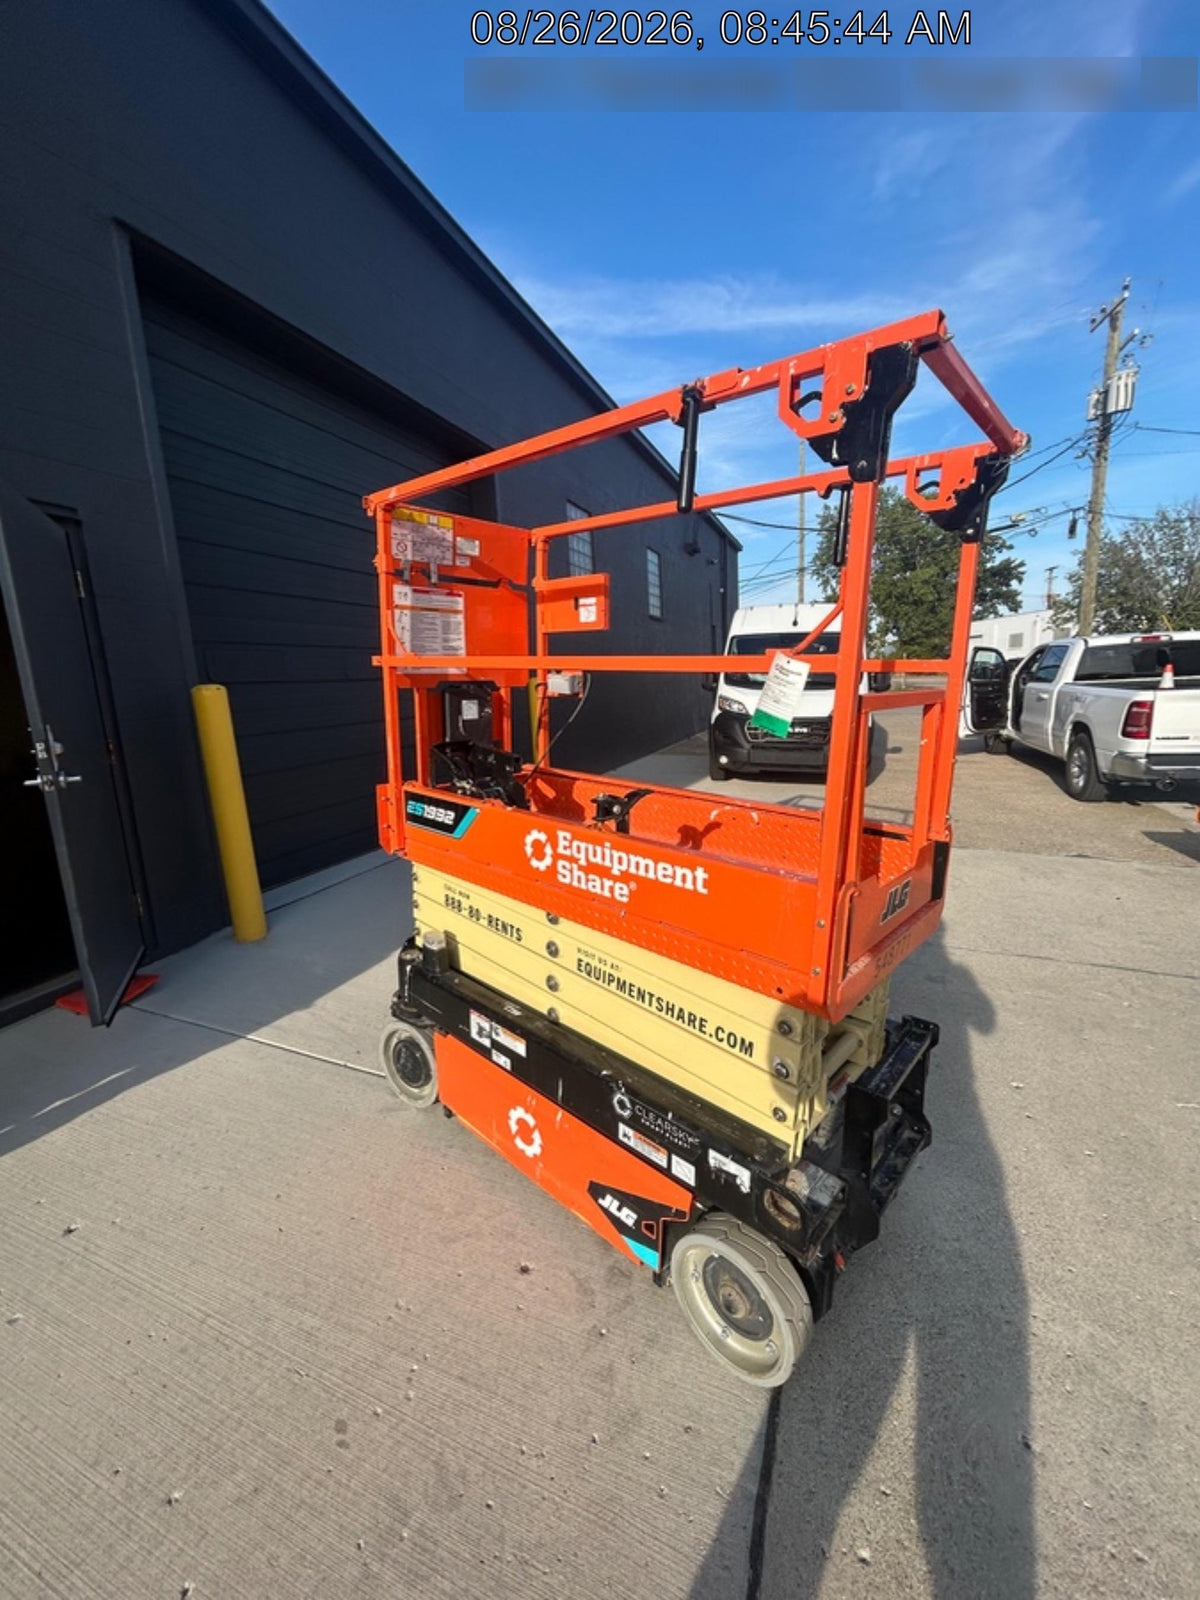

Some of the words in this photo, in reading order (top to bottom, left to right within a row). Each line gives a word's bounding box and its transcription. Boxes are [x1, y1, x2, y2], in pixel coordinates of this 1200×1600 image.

[406, 800, 456, 826] ES1932
[556, 829, 710, 895] Equipment
[444, 893, 524, 942] 888-80-RENTS
[576, 957, 756, 1058] EQUIPMENTSHARE.COM
[597, 1193, 639, 1229] JLG
